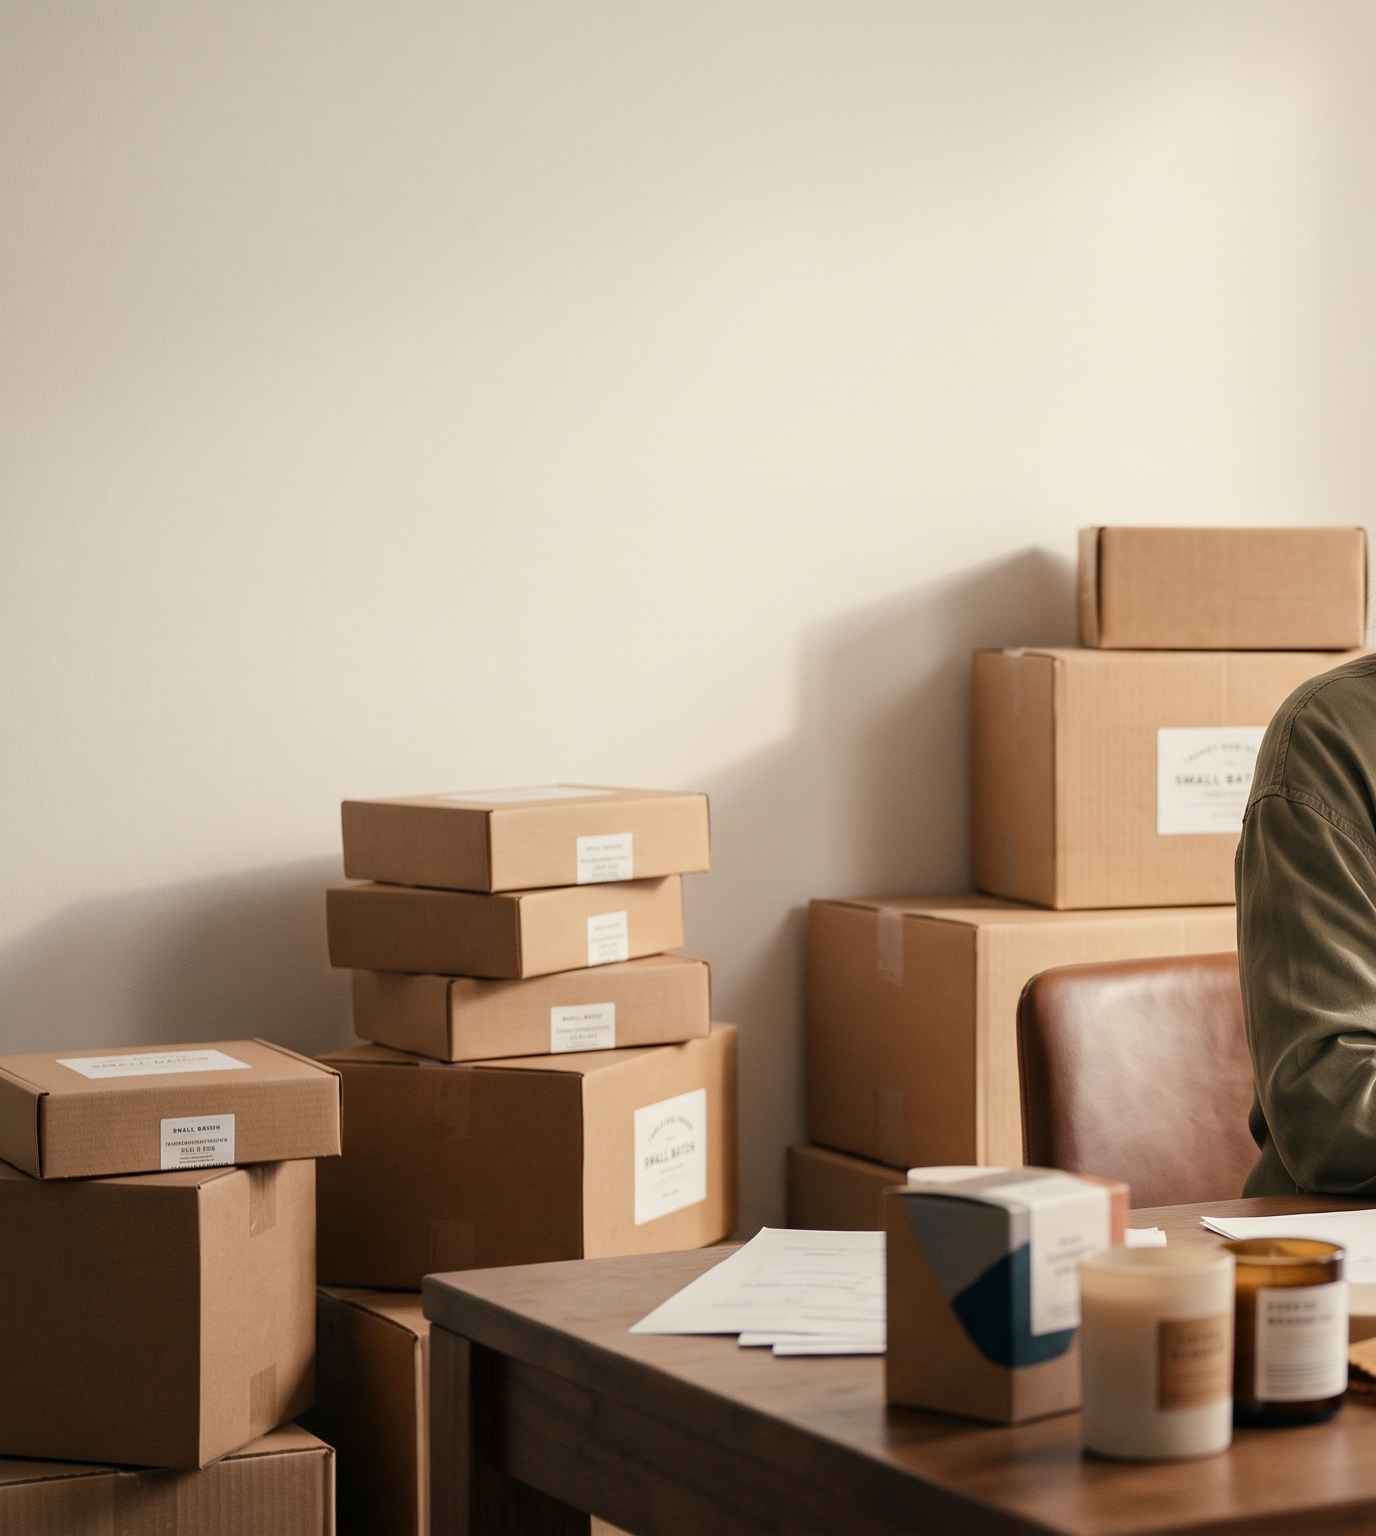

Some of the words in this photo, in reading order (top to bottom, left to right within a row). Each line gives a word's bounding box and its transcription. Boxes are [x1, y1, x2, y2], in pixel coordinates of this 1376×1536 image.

[1174, 774, 1220, 786] SMALL
[1226, 773, 1253, 785] BAT
[644, 1150, 669, 1169] SMALL
